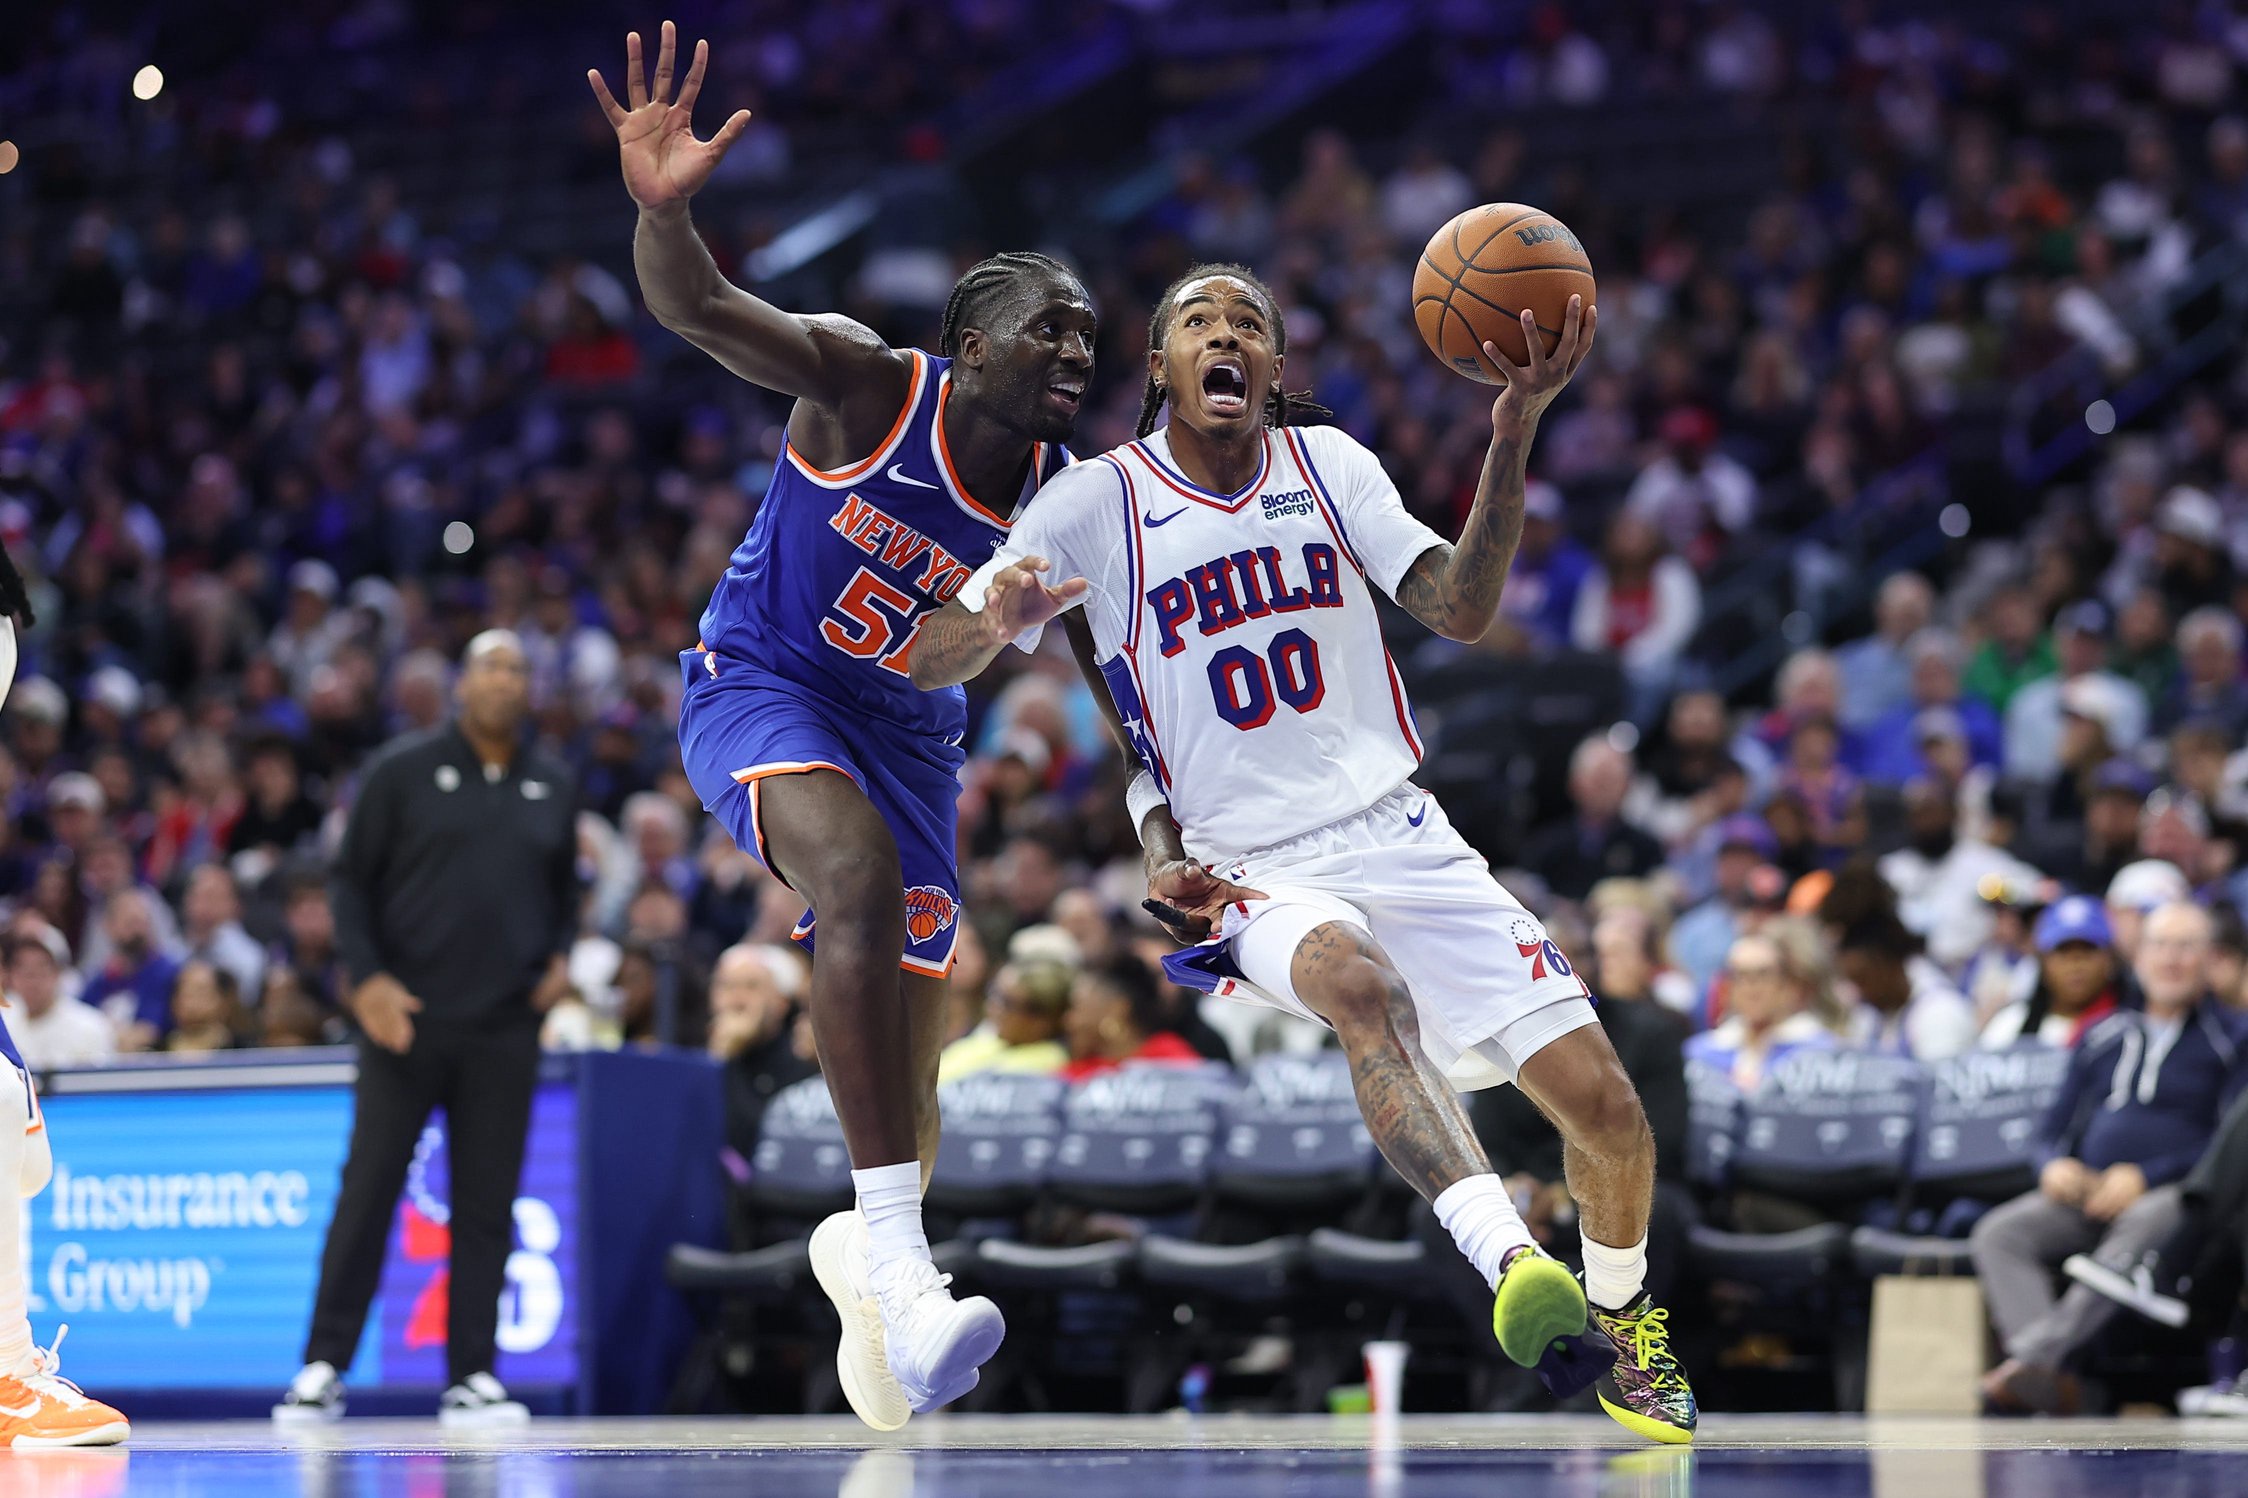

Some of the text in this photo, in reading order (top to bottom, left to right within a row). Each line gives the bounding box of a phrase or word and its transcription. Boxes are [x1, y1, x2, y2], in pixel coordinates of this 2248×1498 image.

[1260, 489, 1312, 510] Bloom
[1264, 500, 1314, 520] energy
[827, 491, 976, 604] NEW YO
[1146, 543, 1344, 659] PHILA
[1207, 627, 1326, 732] 00
[905, 889, 952, 923] KNICKS
[1516, 939, 1571, 982] 76
[52, 1163, 309, 1231] Insurance
[47, 1241, 211, 1329] Group
